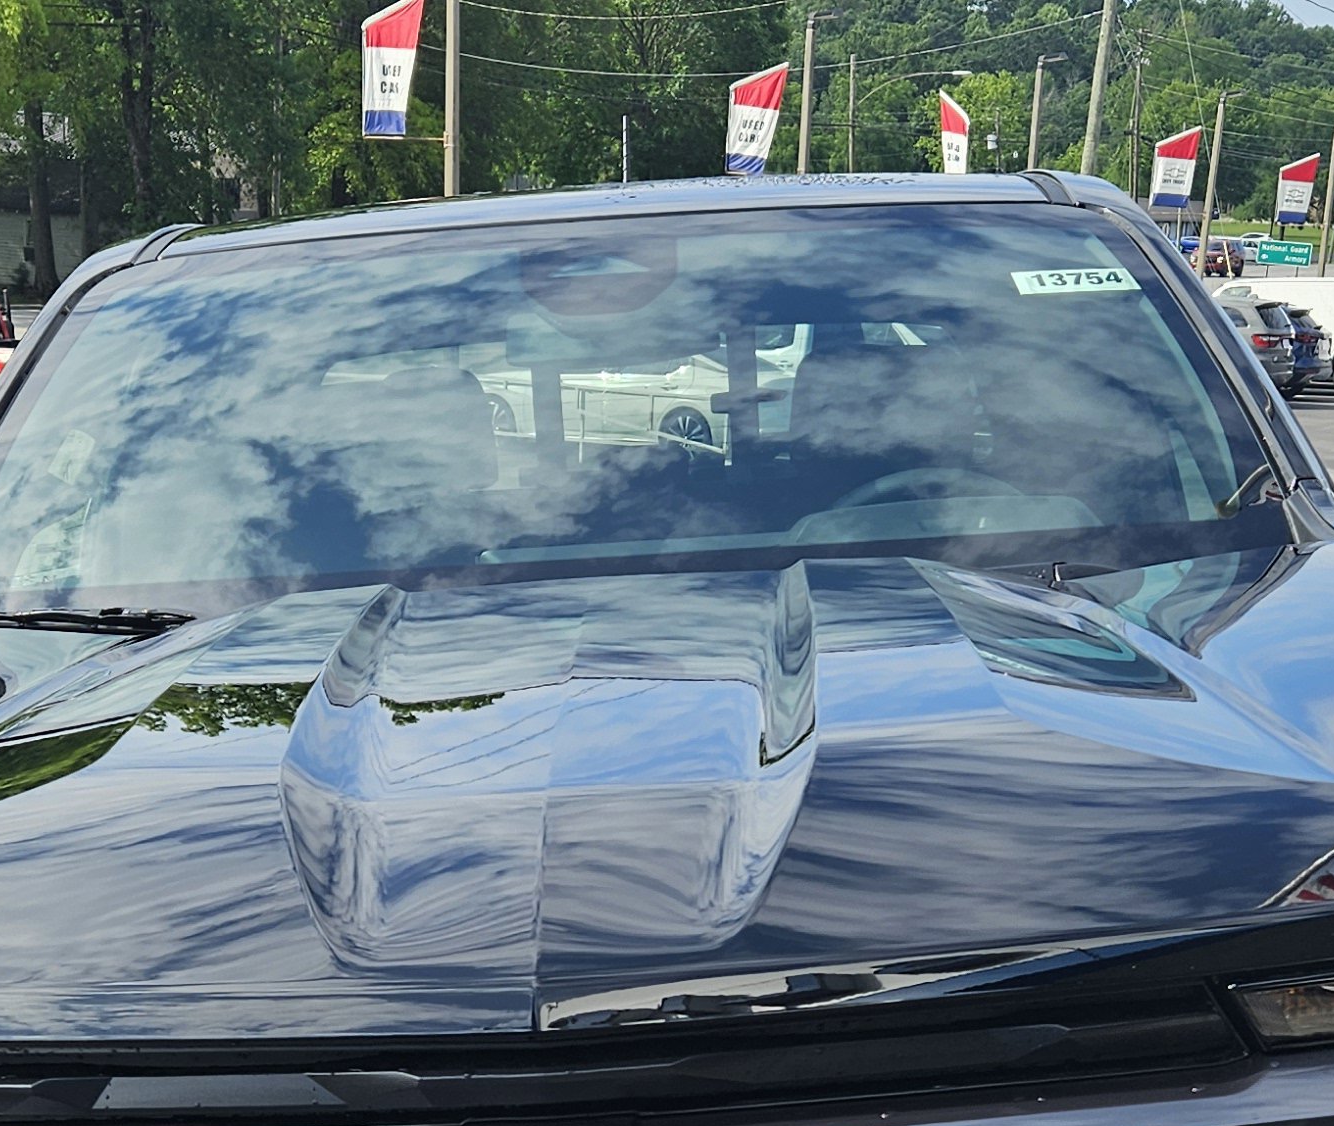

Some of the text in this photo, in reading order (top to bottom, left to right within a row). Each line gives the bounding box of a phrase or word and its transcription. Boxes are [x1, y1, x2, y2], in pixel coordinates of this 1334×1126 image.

[742, 119, 765, 131] USED
[1261, 244, 1288, 252] National
[1284, 255, 1307, 264] Armory
[1030, 271, 1123, 287] 13754
